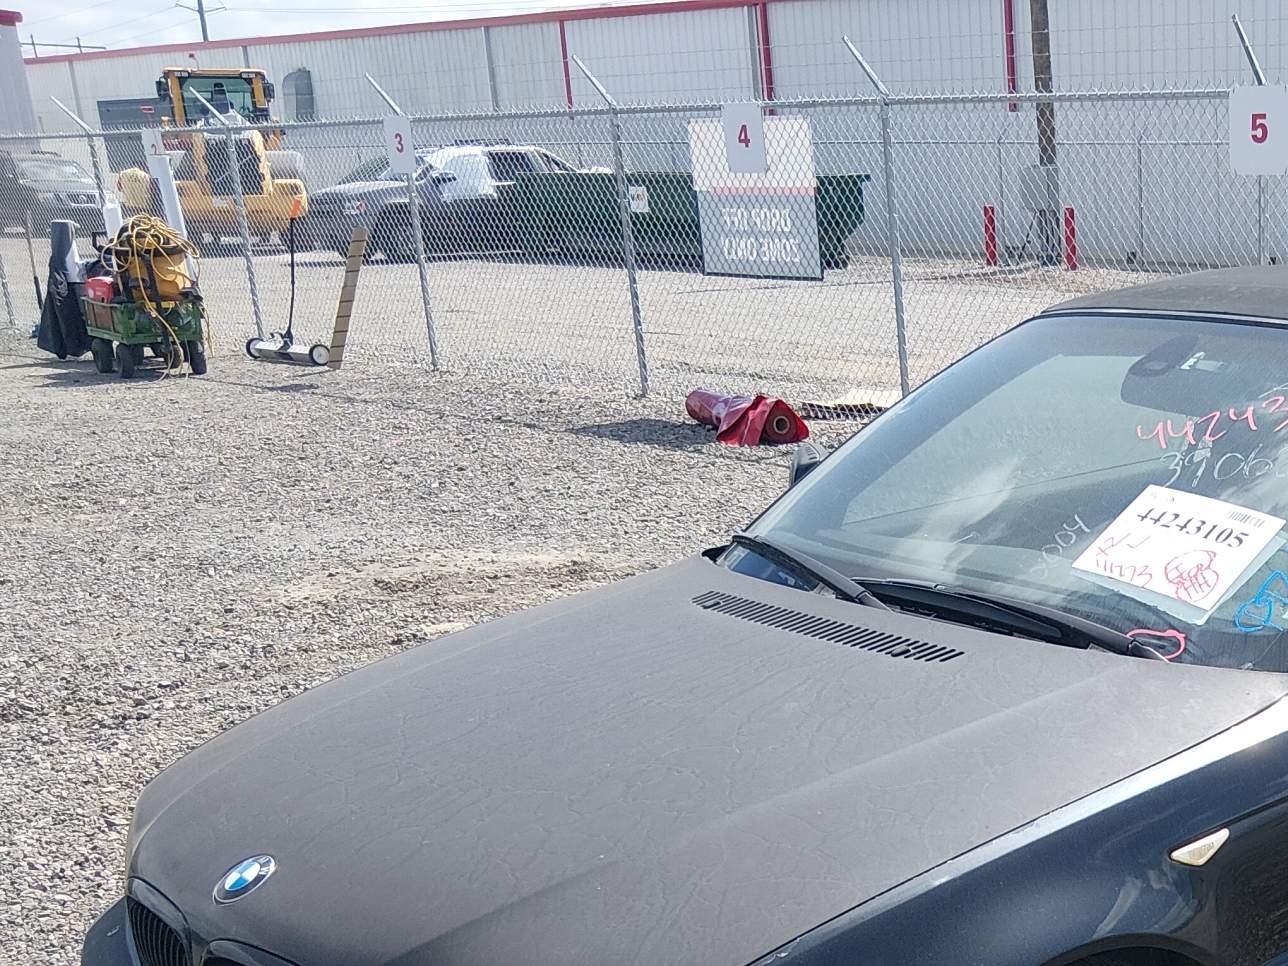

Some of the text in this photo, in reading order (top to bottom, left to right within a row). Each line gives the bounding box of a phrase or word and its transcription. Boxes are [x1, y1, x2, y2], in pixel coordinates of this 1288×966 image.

[738, 124, 751, 148] 4
[1251, 113, 1268, 144] 5
[394, 133, 404, 153] 3
[1136, 507, 1250, 549] 44243105
